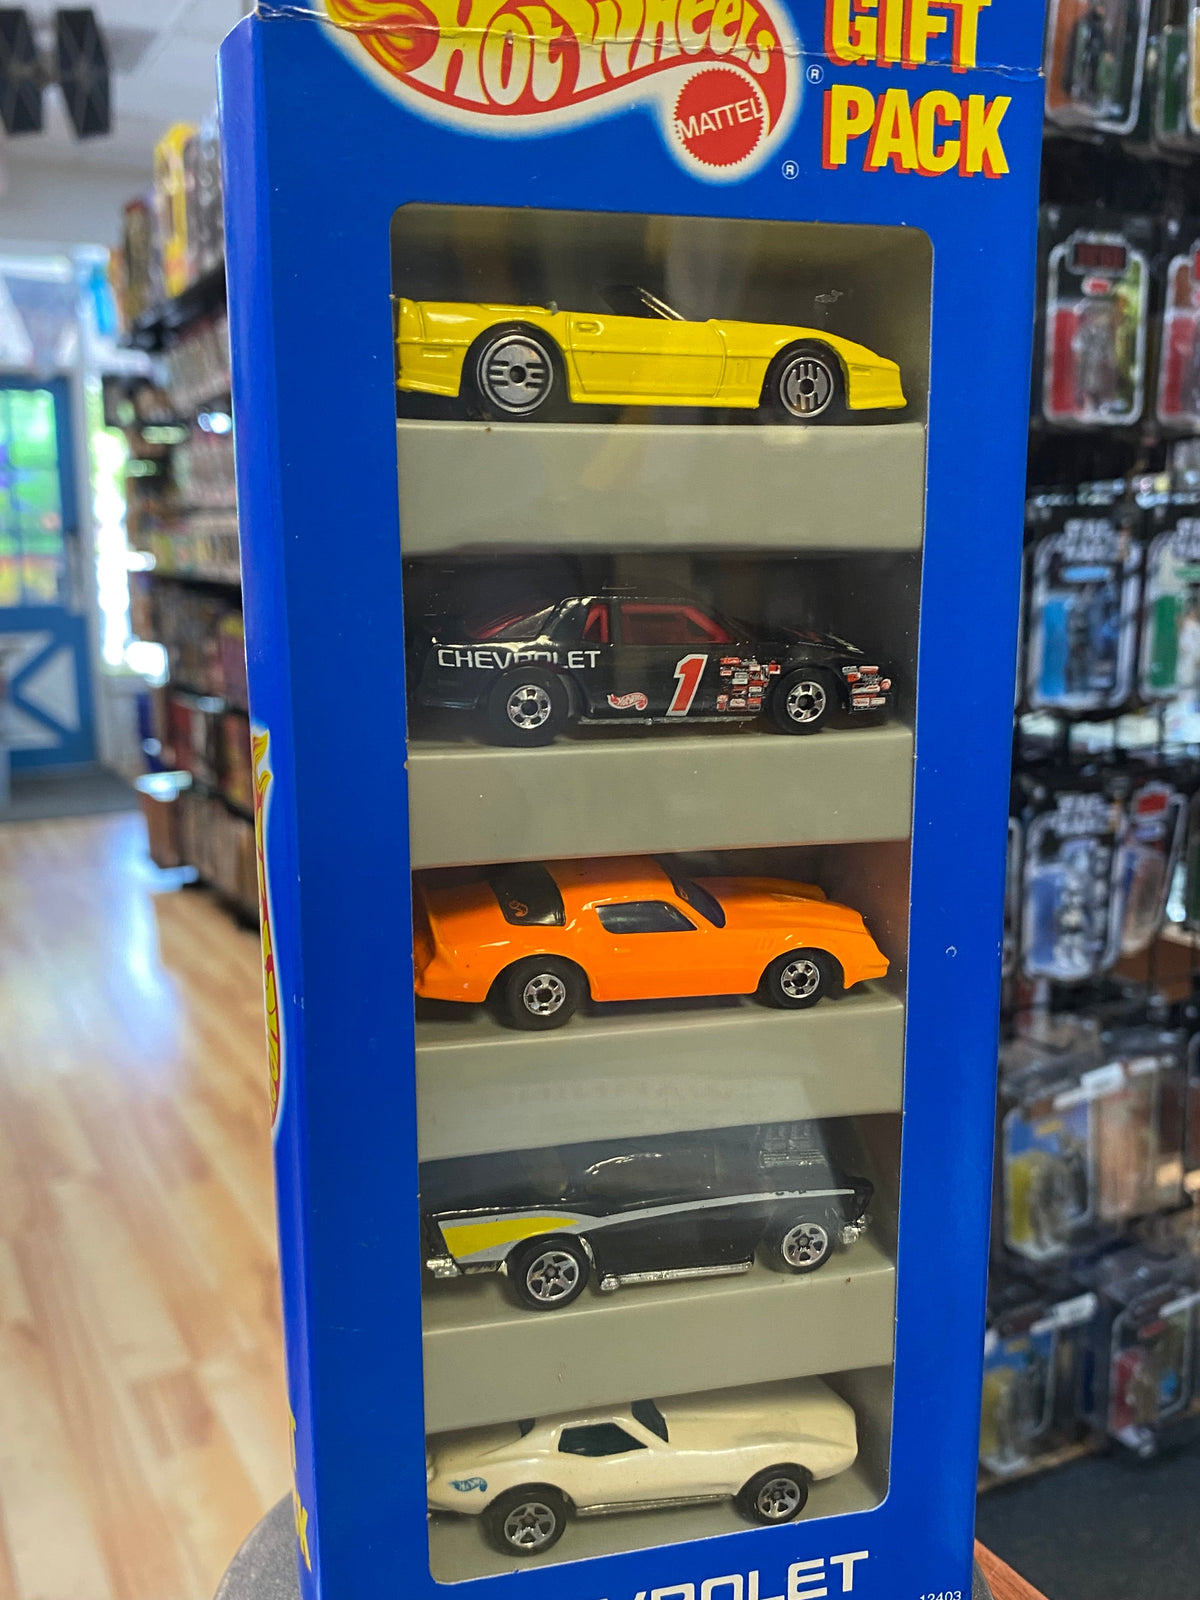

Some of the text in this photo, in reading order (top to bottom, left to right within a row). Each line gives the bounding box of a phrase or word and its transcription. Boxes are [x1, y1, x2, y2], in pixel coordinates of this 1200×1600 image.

[824, 0, 992, 73] GIFT
[677, 97, 765, 141] MATTEL
[822, 84, 1012, 179] PACK
[665, 653, 709, 717] 1
